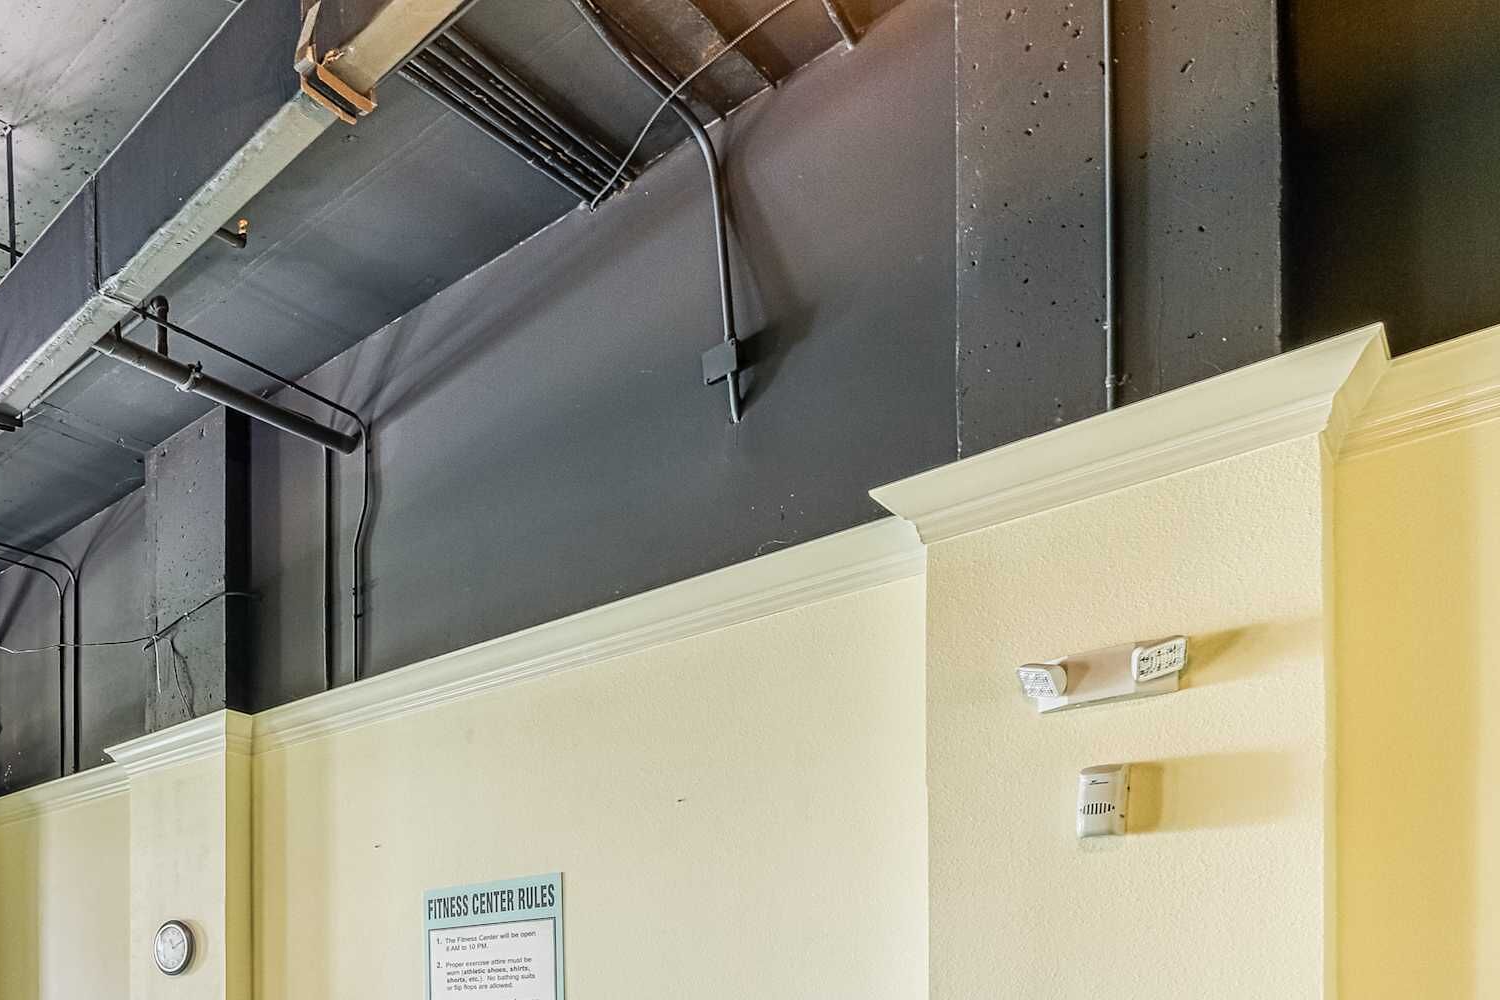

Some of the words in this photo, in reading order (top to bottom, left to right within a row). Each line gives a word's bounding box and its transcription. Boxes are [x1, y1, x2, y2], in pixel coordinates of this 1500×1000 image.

[428, 894, 468, 920] FITNESS
[472, 889, 514, 915] CENTER
[518, 884, 555, 910] RULES
[446, 961, 464, 969] Proper
